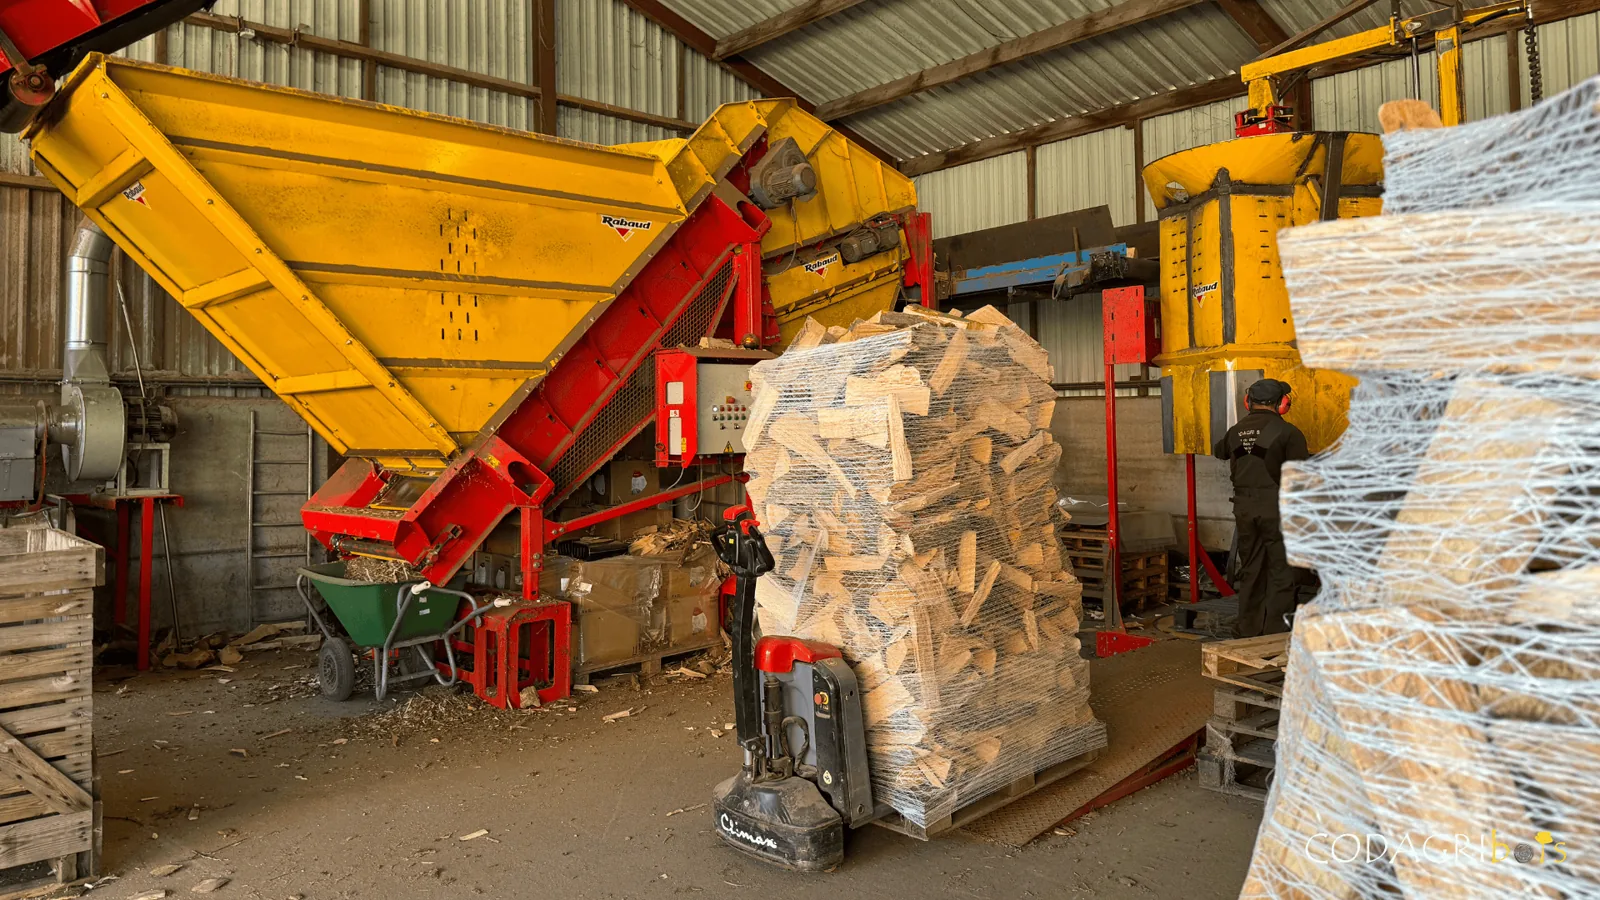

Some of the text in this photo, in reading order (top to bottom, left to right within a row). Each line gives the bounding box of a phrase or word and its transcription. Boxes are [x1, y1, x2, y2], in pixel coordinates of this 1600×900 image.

[601, 215, 652, 229] Rabaud
[804, 254, 838, 272] Rabaud
[720, 813, 778, 849] Climax
